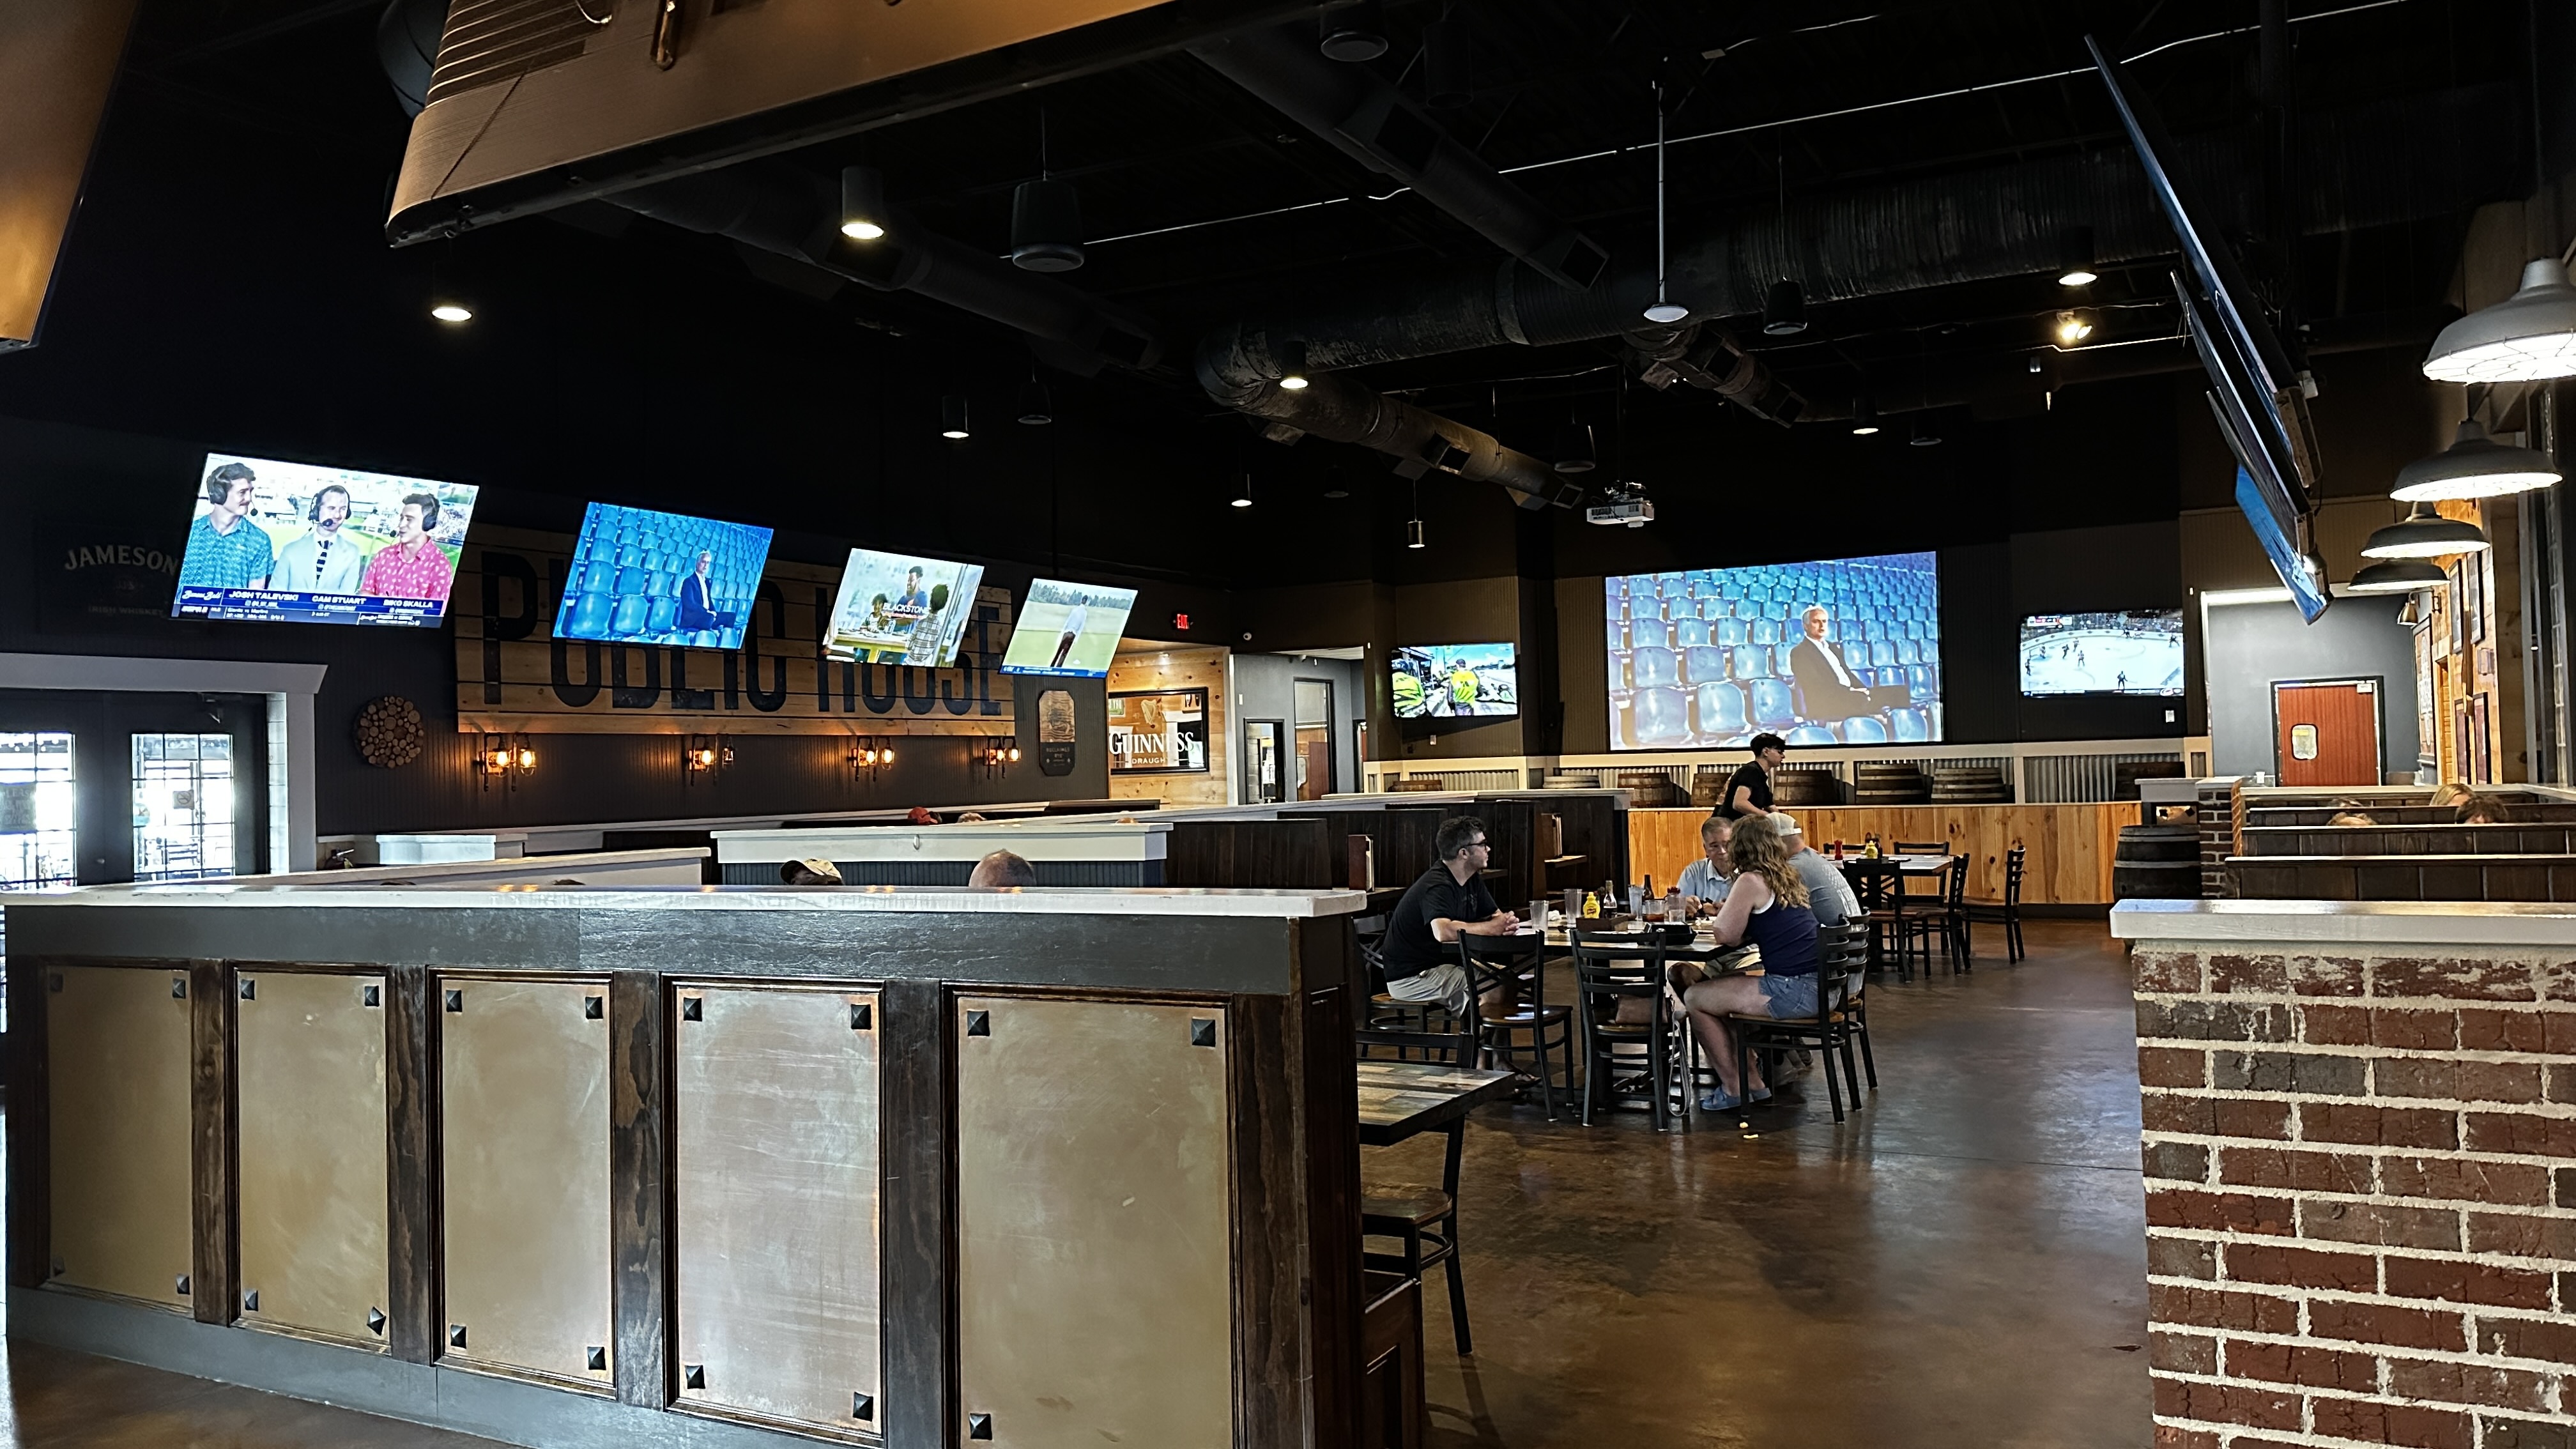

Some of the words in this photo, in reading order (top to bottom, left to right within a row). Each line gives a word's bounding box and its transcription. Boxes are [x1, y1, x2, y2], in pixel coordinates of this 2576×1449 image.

[65, 545, 179, 576] JAMESON
[229, 590, 254, 599] JOSH
[332, 596, 367, 605] STUART
[88, 605, 116, 617] IRISH
[119, 606, 164, 617] WHISKEY
[882, 602, 930, 614] BLACKSTONE
